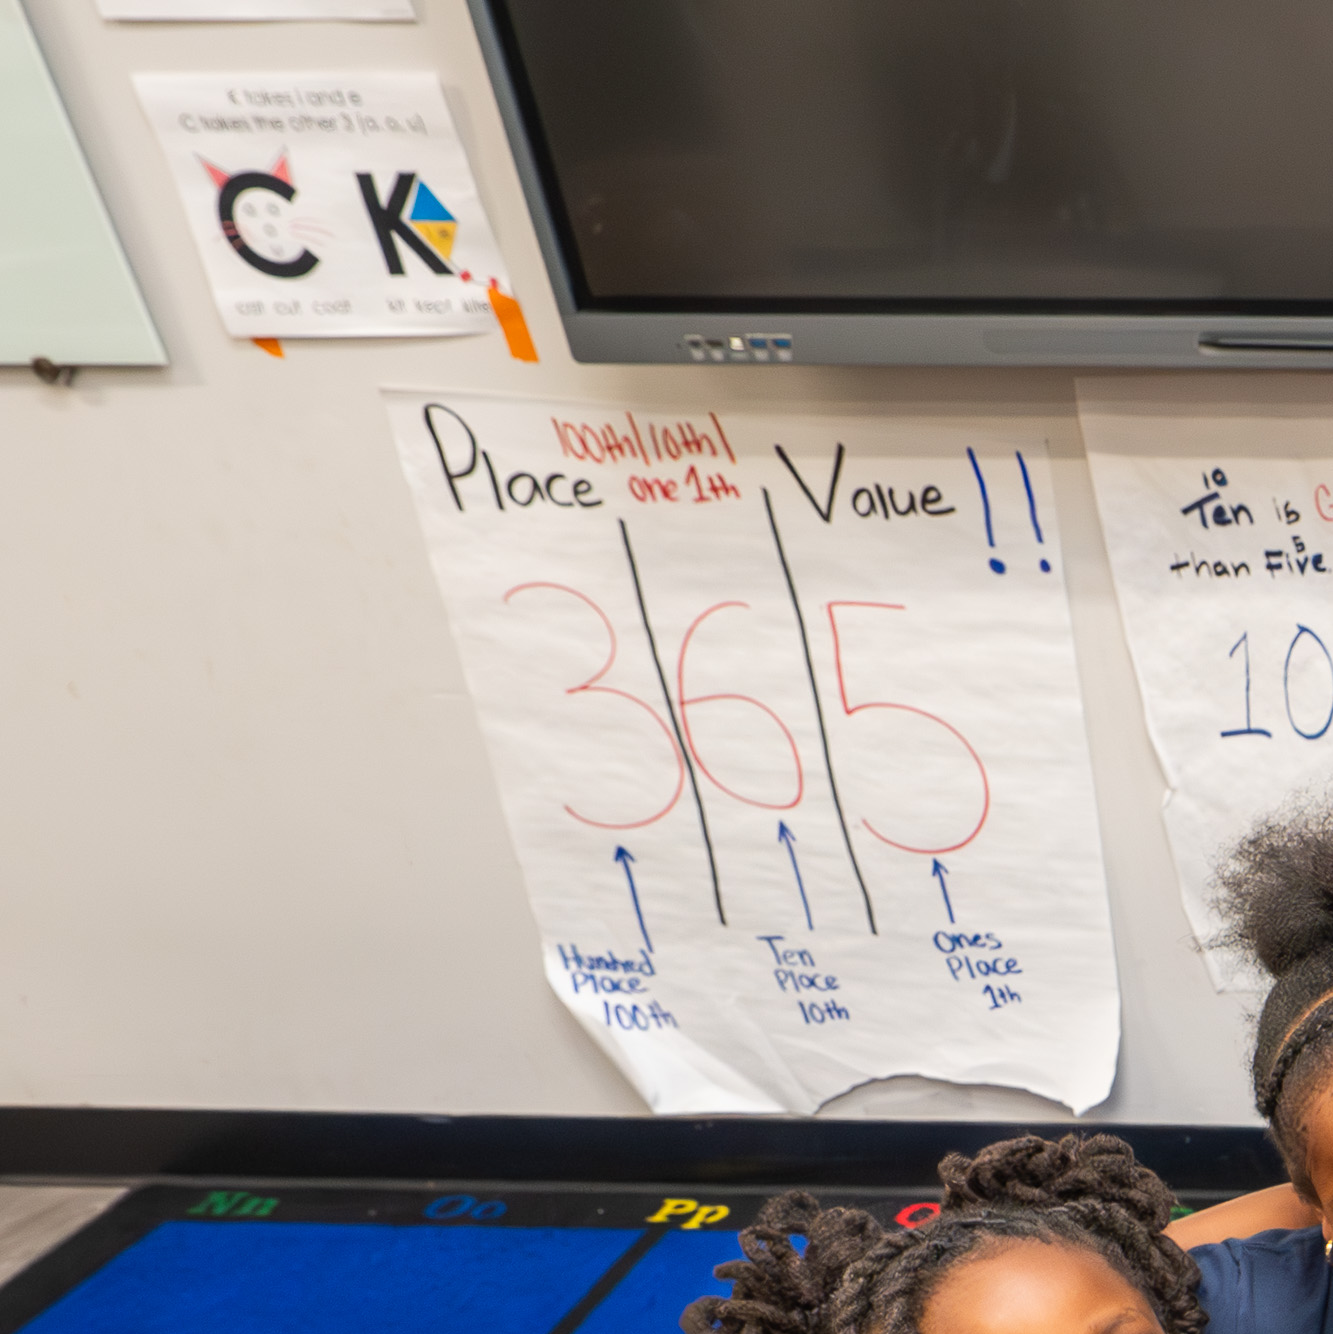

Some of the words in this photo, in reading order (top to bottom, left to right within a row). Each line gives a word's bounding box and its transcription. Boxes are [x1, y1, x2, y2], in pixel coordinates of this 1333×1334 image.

[178, 112, 199, 133] C
[218, 170, 320, 279] C
[354, 171, 455, 276] K
[424, 402, 603, 511] Place
[628, 474, 680, 503] one
[1181, 491, 1254, 530] Ten
[1272, 497, 1301, 525] is
[1169, 551, 1251, 580] than
[757, 936, 817, 967] Ten
[571, 972, 649, 995] Place
[774, 968, 841, 994] Place
[945, 956, 1024, 982] Place
[602, 1000, 680, 1032] 100th
[799, 1000, 851, 1026] 10th
[645, 1198, 731, 1230] Pp
